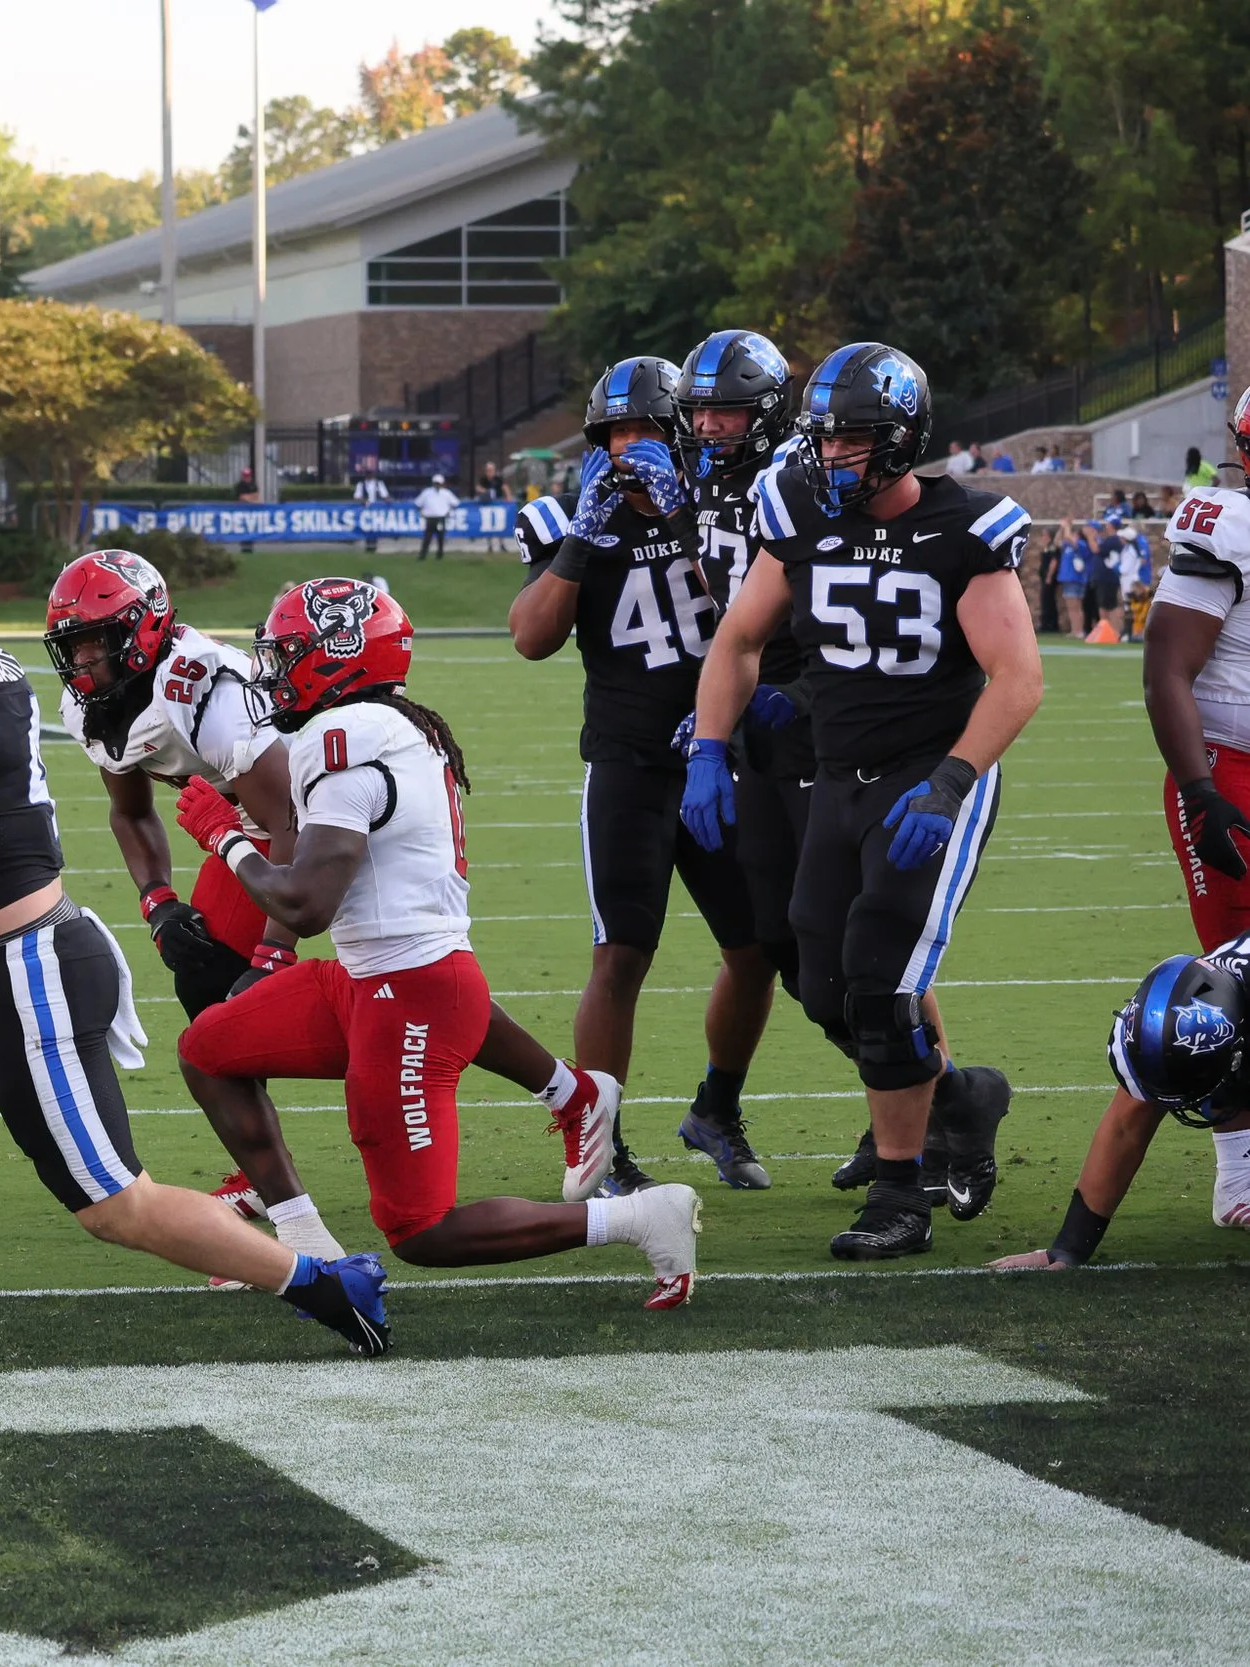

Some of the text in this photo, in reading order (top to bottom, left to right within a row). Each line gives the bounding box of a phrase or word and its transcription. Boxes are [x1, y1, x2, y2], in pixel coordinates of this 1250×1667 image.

[220, 510, 287, 534] DEVILS
[290, 509, 356, 533] SKILLS
[359, 509, 469, 533] CHALLGE
[734, 507, 744, 531] C
[1177, 498, 1223, 536] 52
[632, 540, 682, 562] DUKE
[853, 546, 903, 565] DUKE
[333, 584, 352, 595] STATE
[610, 557, 719, 670] 46
[810, 565, 942, 676] 53
[323, 728, 348, 772] 0
[400, 1021, 433, 1152] WOLFPACK
